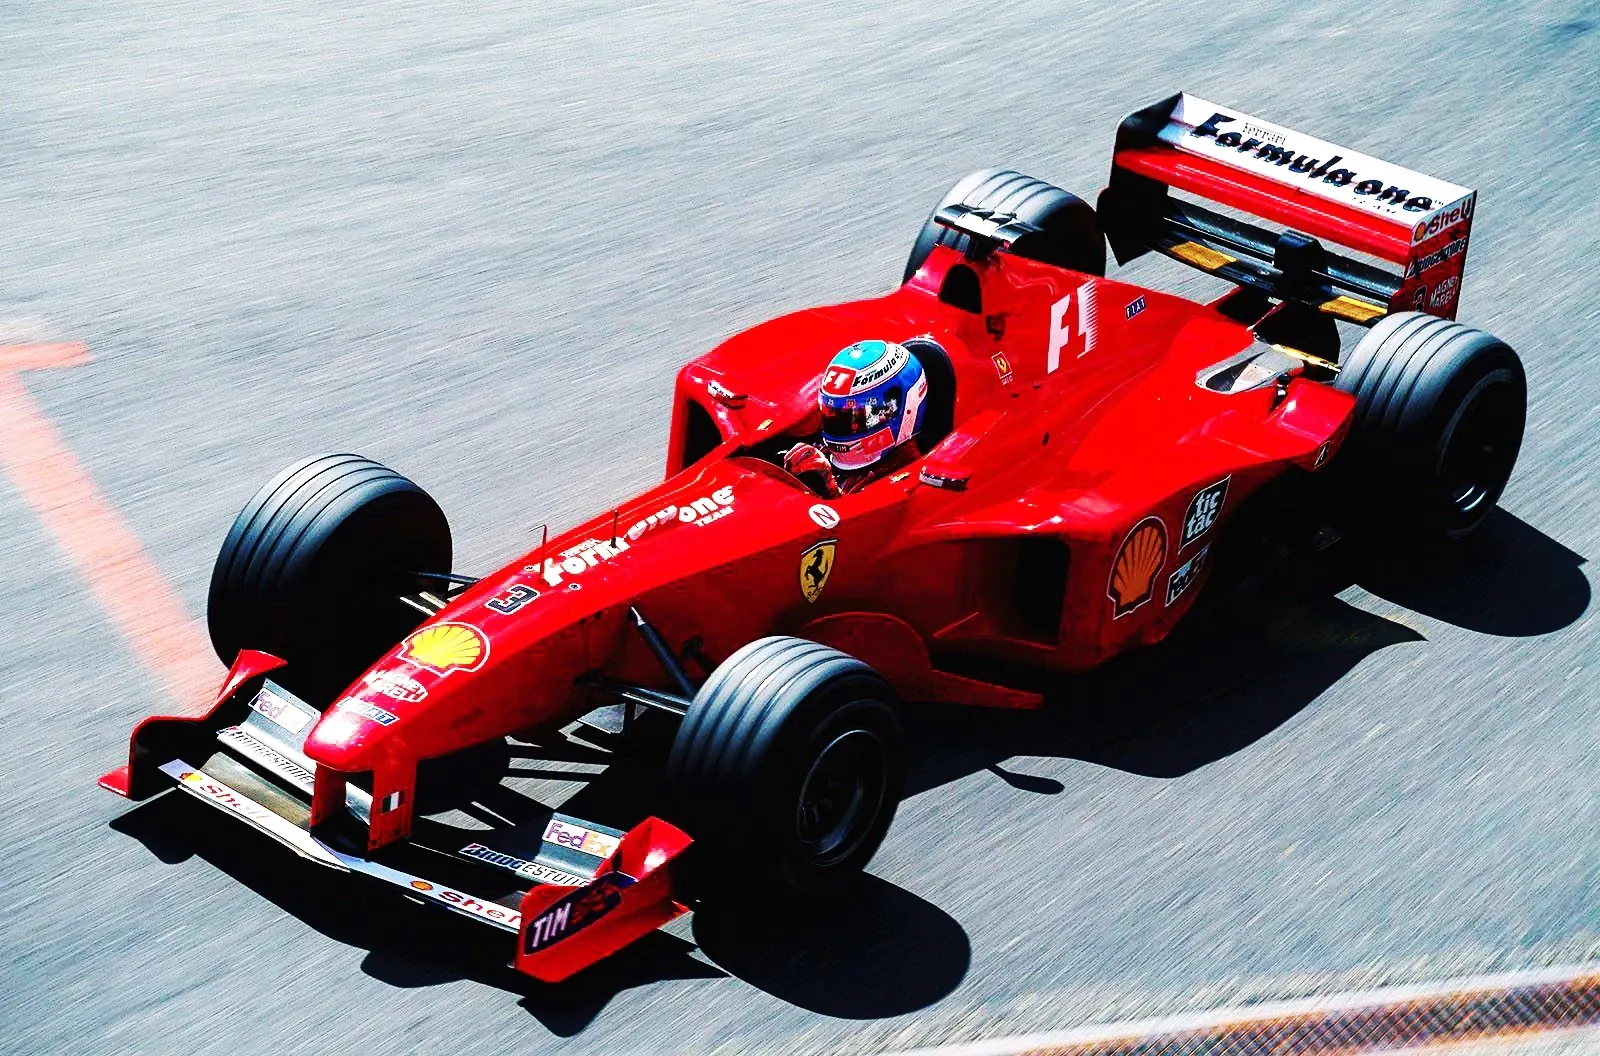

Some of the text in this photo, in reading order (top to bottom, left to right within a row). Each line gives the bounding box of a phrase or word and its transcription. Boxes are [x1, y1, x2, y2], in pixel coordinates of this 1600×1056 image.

[1191, 112, 1433, 212] Formula one
[1426, 198, 1472, 234] Shell
[1126, 297, 1146, 318] FIAT
[1047, 279, 1098, 374] F1
[823, 371, 850, 390] F1
[852, 357, 897, 388] Formula
[679, 485, 735, 523] one
[1195, 491, 1221, 517] tic
[1186, 509, 1216, 539] tac
[485, 584, 541, 615] 3
[546, 822, 612, 857] FedEx
[531, 902, 572, 948] TIM
